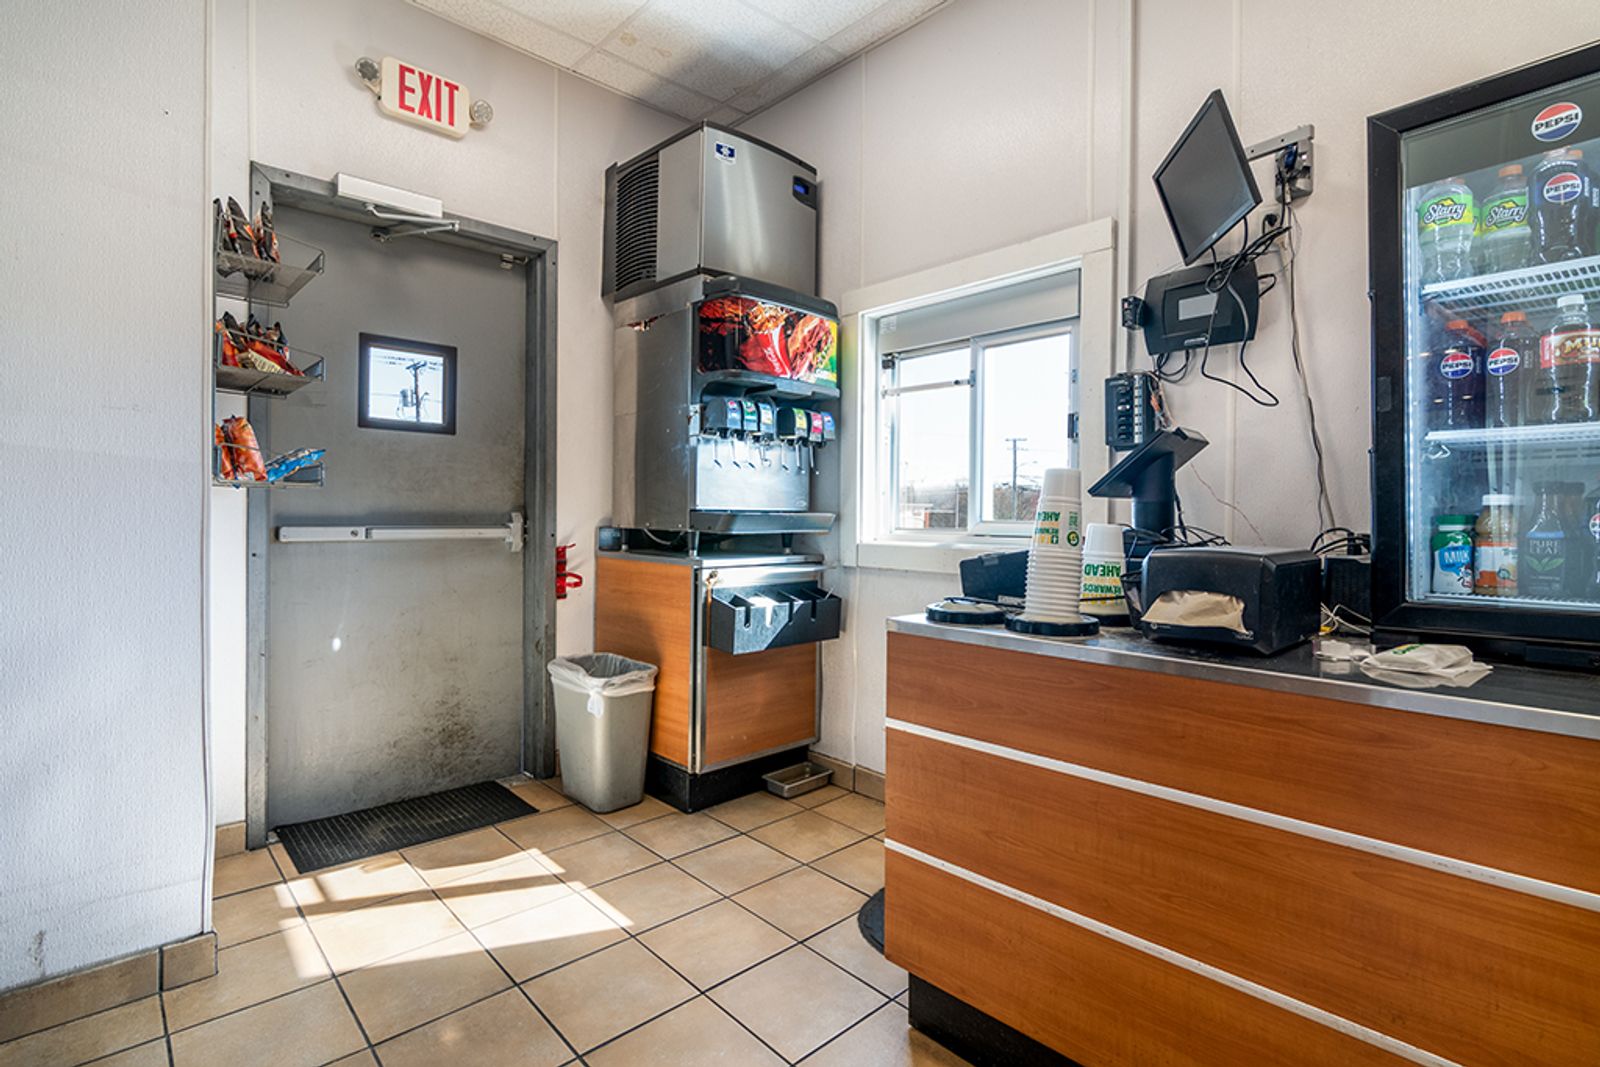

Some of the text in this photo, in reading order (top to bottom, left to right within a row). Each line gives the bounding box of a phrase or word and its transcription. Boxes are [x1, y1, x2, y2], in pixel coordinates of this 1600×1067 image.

[398, 63, 459, 127] EXIT
[1534, 112, 1579, 132] PEPSI
[1545, 182, 1580, 195] PEPSI
[1424, 202, 1467, 224] Starry
[1486, 203, 1527, 227] Starry
[1441, 360, 1473, 370] PEPSI
[1487, 356, 1519, 367] PEPSI
[1084, 564, 1122, 577] AHEAD
[1083, 584, 1122, 595] REWARDS
